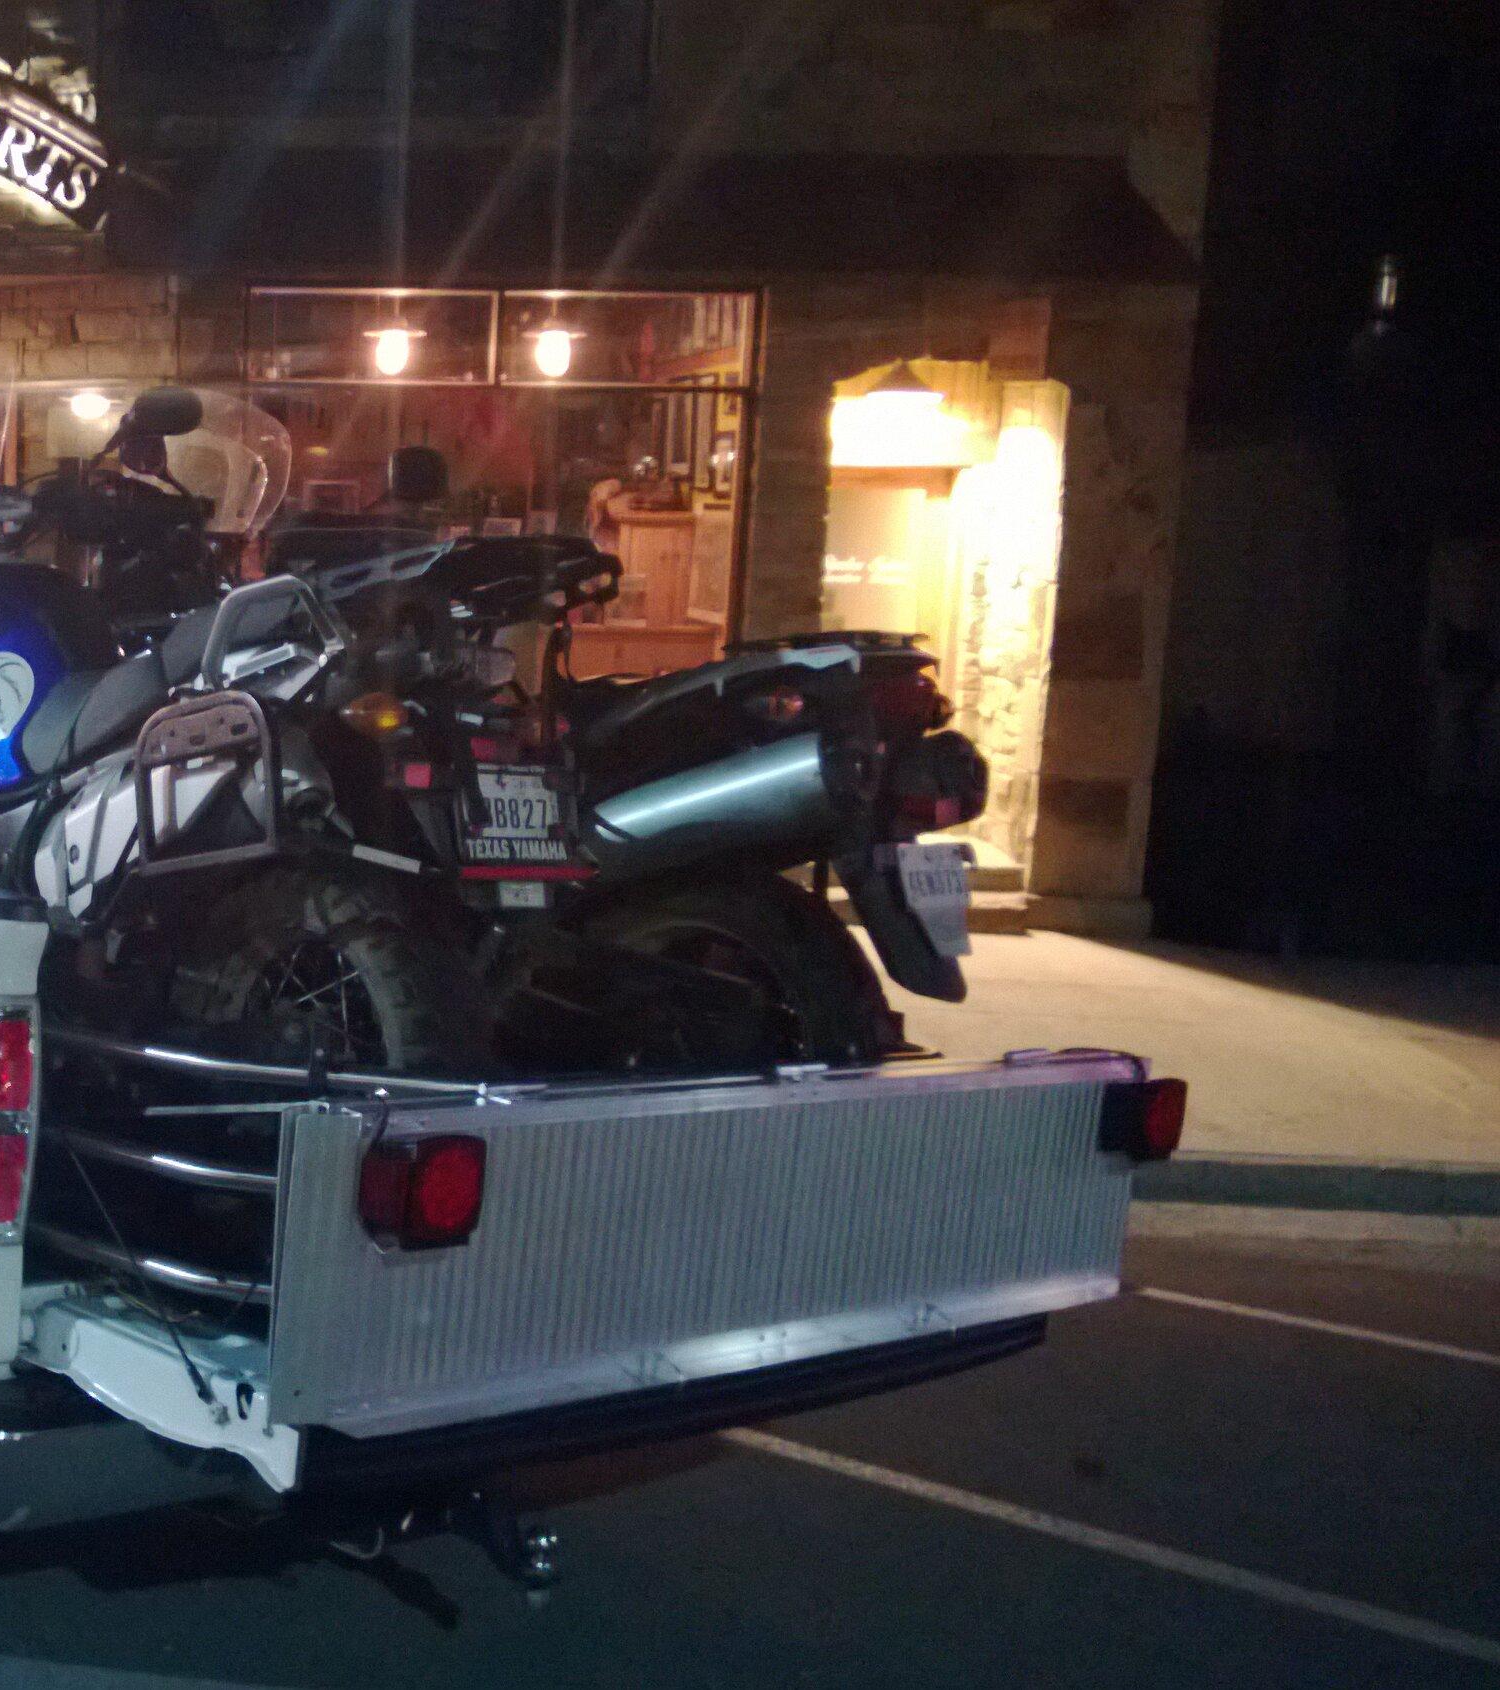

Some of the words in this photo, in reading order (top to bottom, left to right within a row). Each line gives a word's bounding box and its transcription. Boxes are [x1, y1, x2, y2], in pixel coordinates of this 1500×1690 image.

[484, 798, 547, 829] B827
[466, 838, 511, 859] TEXAS
[512, 839, 568, 860] YAMAHA
